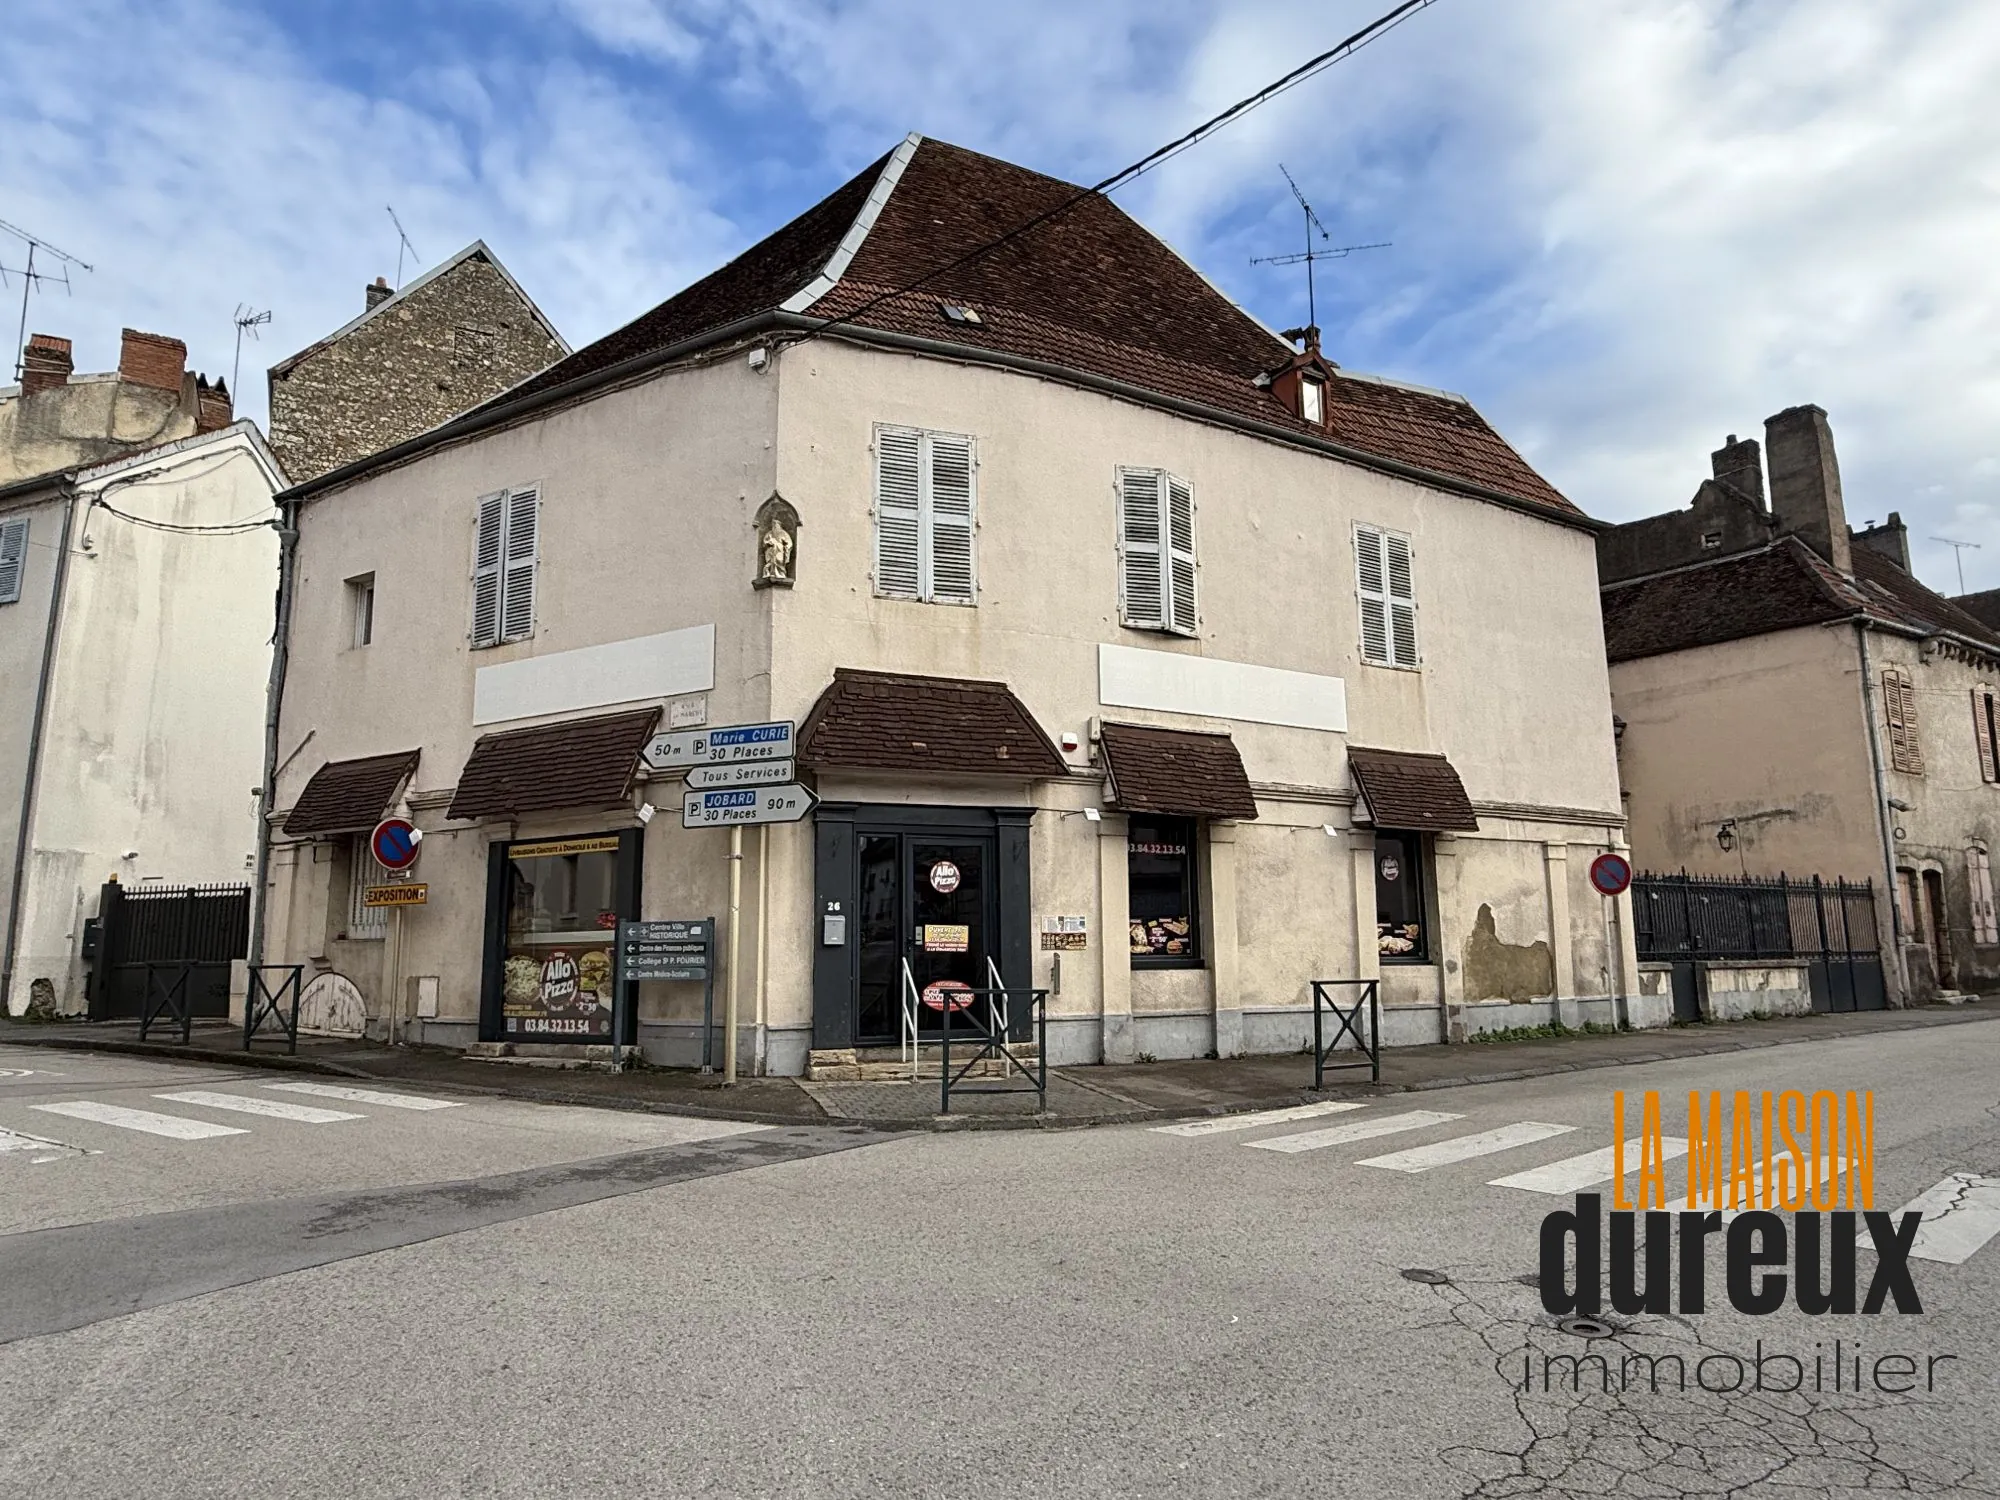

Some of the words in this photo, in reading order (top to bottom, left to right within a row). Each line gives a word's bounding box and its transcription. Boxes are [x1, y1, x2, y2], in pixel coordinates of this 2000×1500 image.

[712, 733, 744, 744] Marie
[752, 727, 788, 740] CURIE
[655, 744, 670, 756] 50
[695, 742, 704, 752] P
[710, 748, 725, 760] 30
[733, 746, 773, 758] Places
[703, 771, 728, 782] Tous
[736, 767, 787, 779] Services
[706, 793, 754, 807] JOBARD
[767, 798, 782, 810] 90
[690, 804, 699, 814] P
[704, 810, 718, 820] 30
[722, 808, 757, 820] Places
[936, 865, 954, 876] Allo
[935, 876, 956, 887] Pizza
[368, 887, 419, 902] EXPOSITION
[828, 901, 840, 911] 26
[649, 931, 688, 939] HISTORIQUE
[638, 957, 661, 966] Collège
[676, 956, 705, 964] FOURIER
[546, 959, 571, 980] Allo
[544, 980, 574, 999] Pizza
[524, 1019, 589, 1033] 03.84.32.13.54
